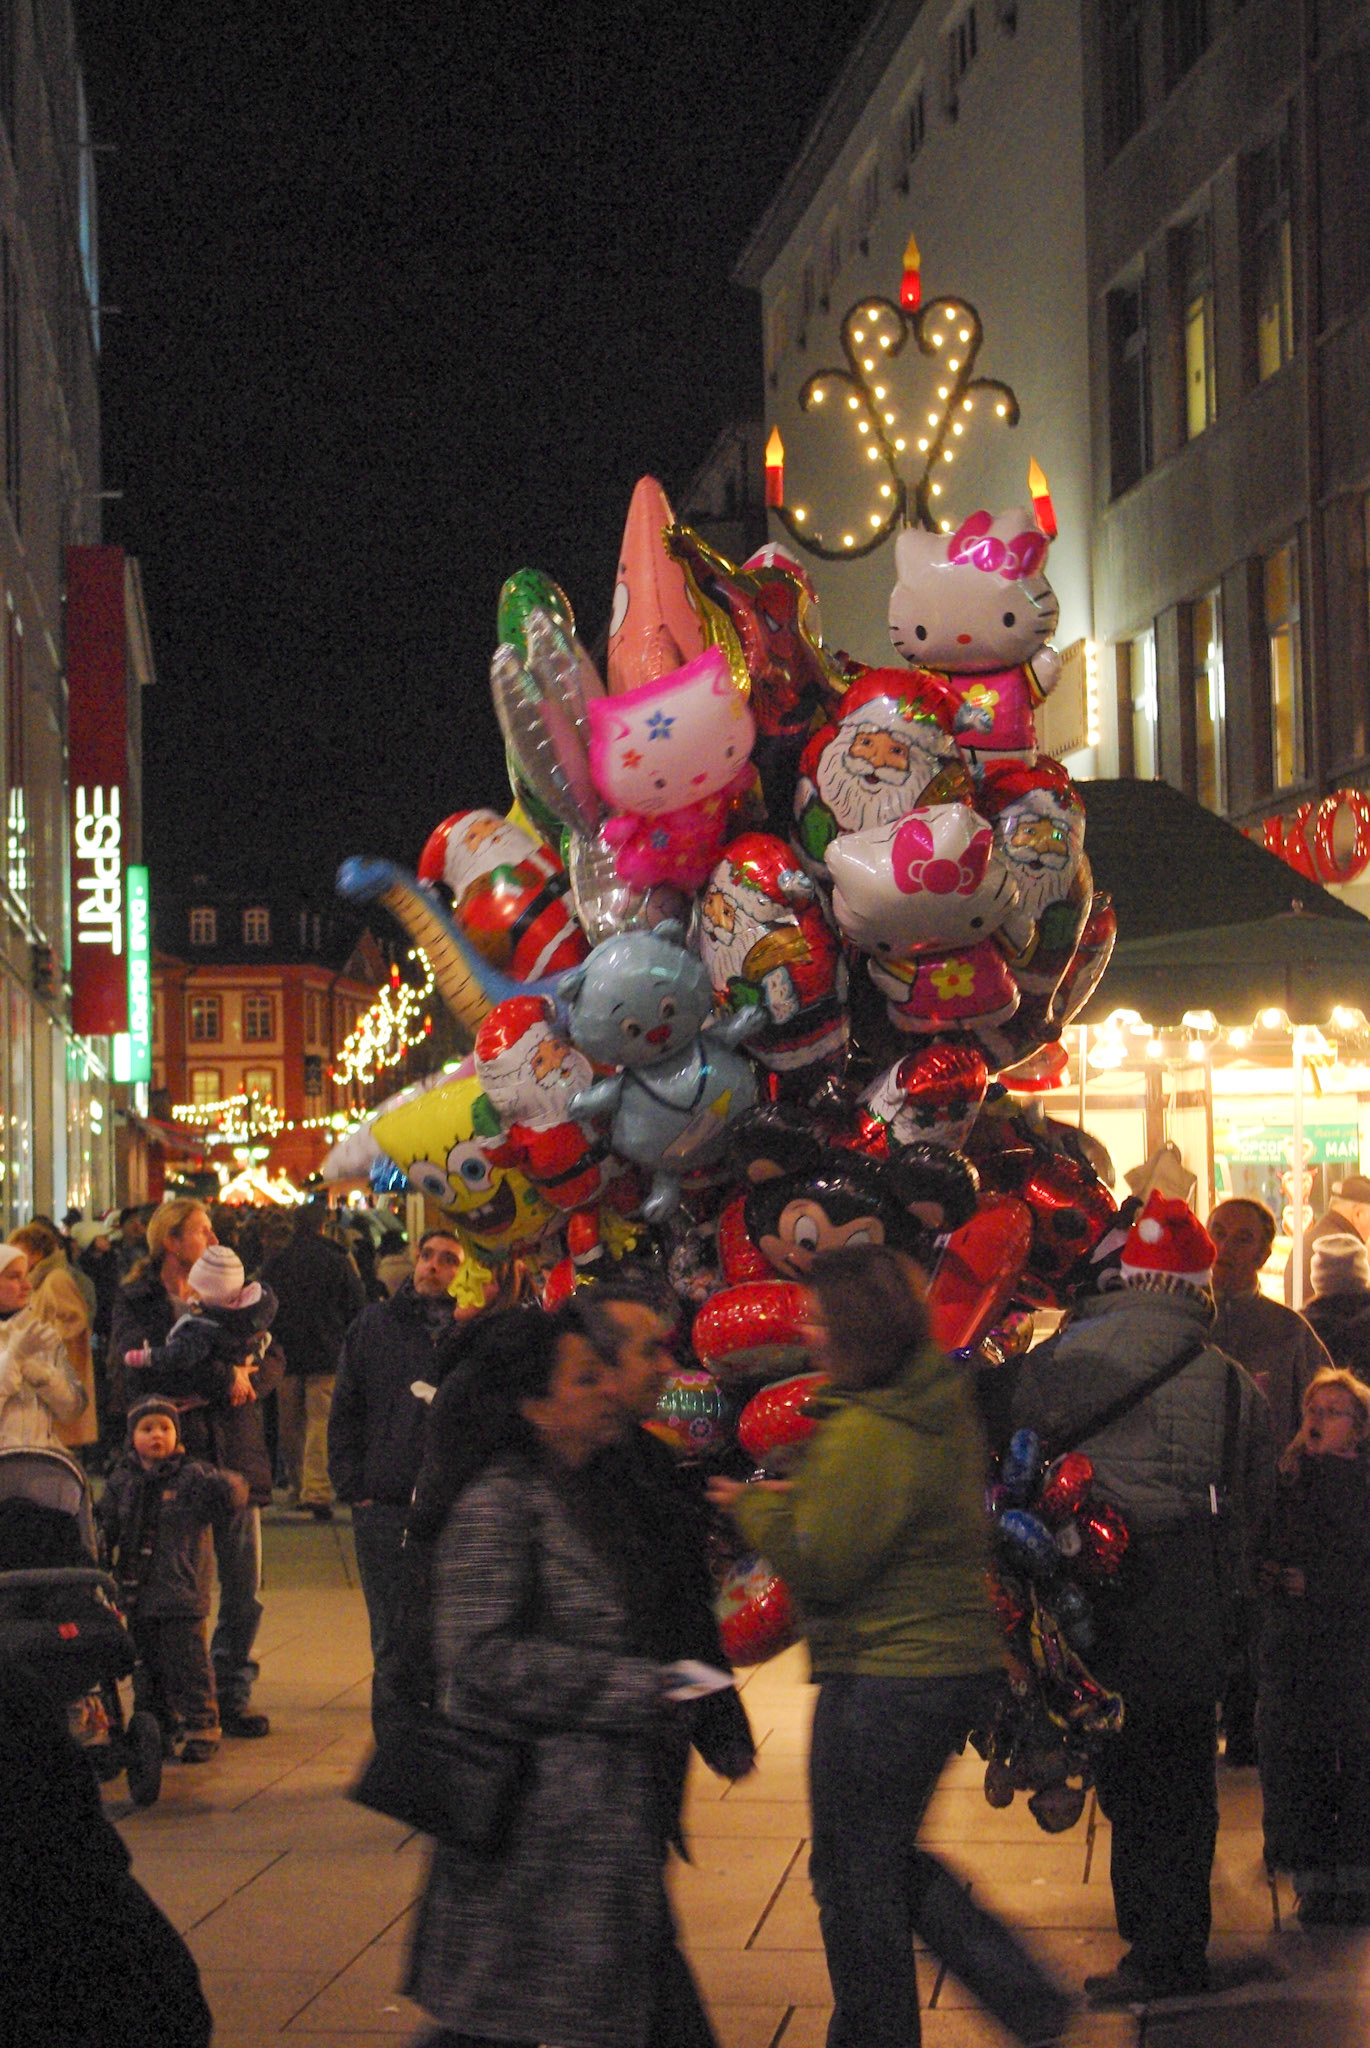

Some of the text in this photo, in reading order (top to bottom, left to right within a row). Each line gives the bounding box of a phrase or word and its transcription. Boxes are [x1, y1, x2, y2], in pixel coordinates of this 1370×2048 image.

[75, 785, 122, 956] ESPRIT
[1241, 788, 1370, 885] KO
[130, 899, 149, 1046] DAS DEPOT
[1231, 1139, 1284, 1155] OPCO
